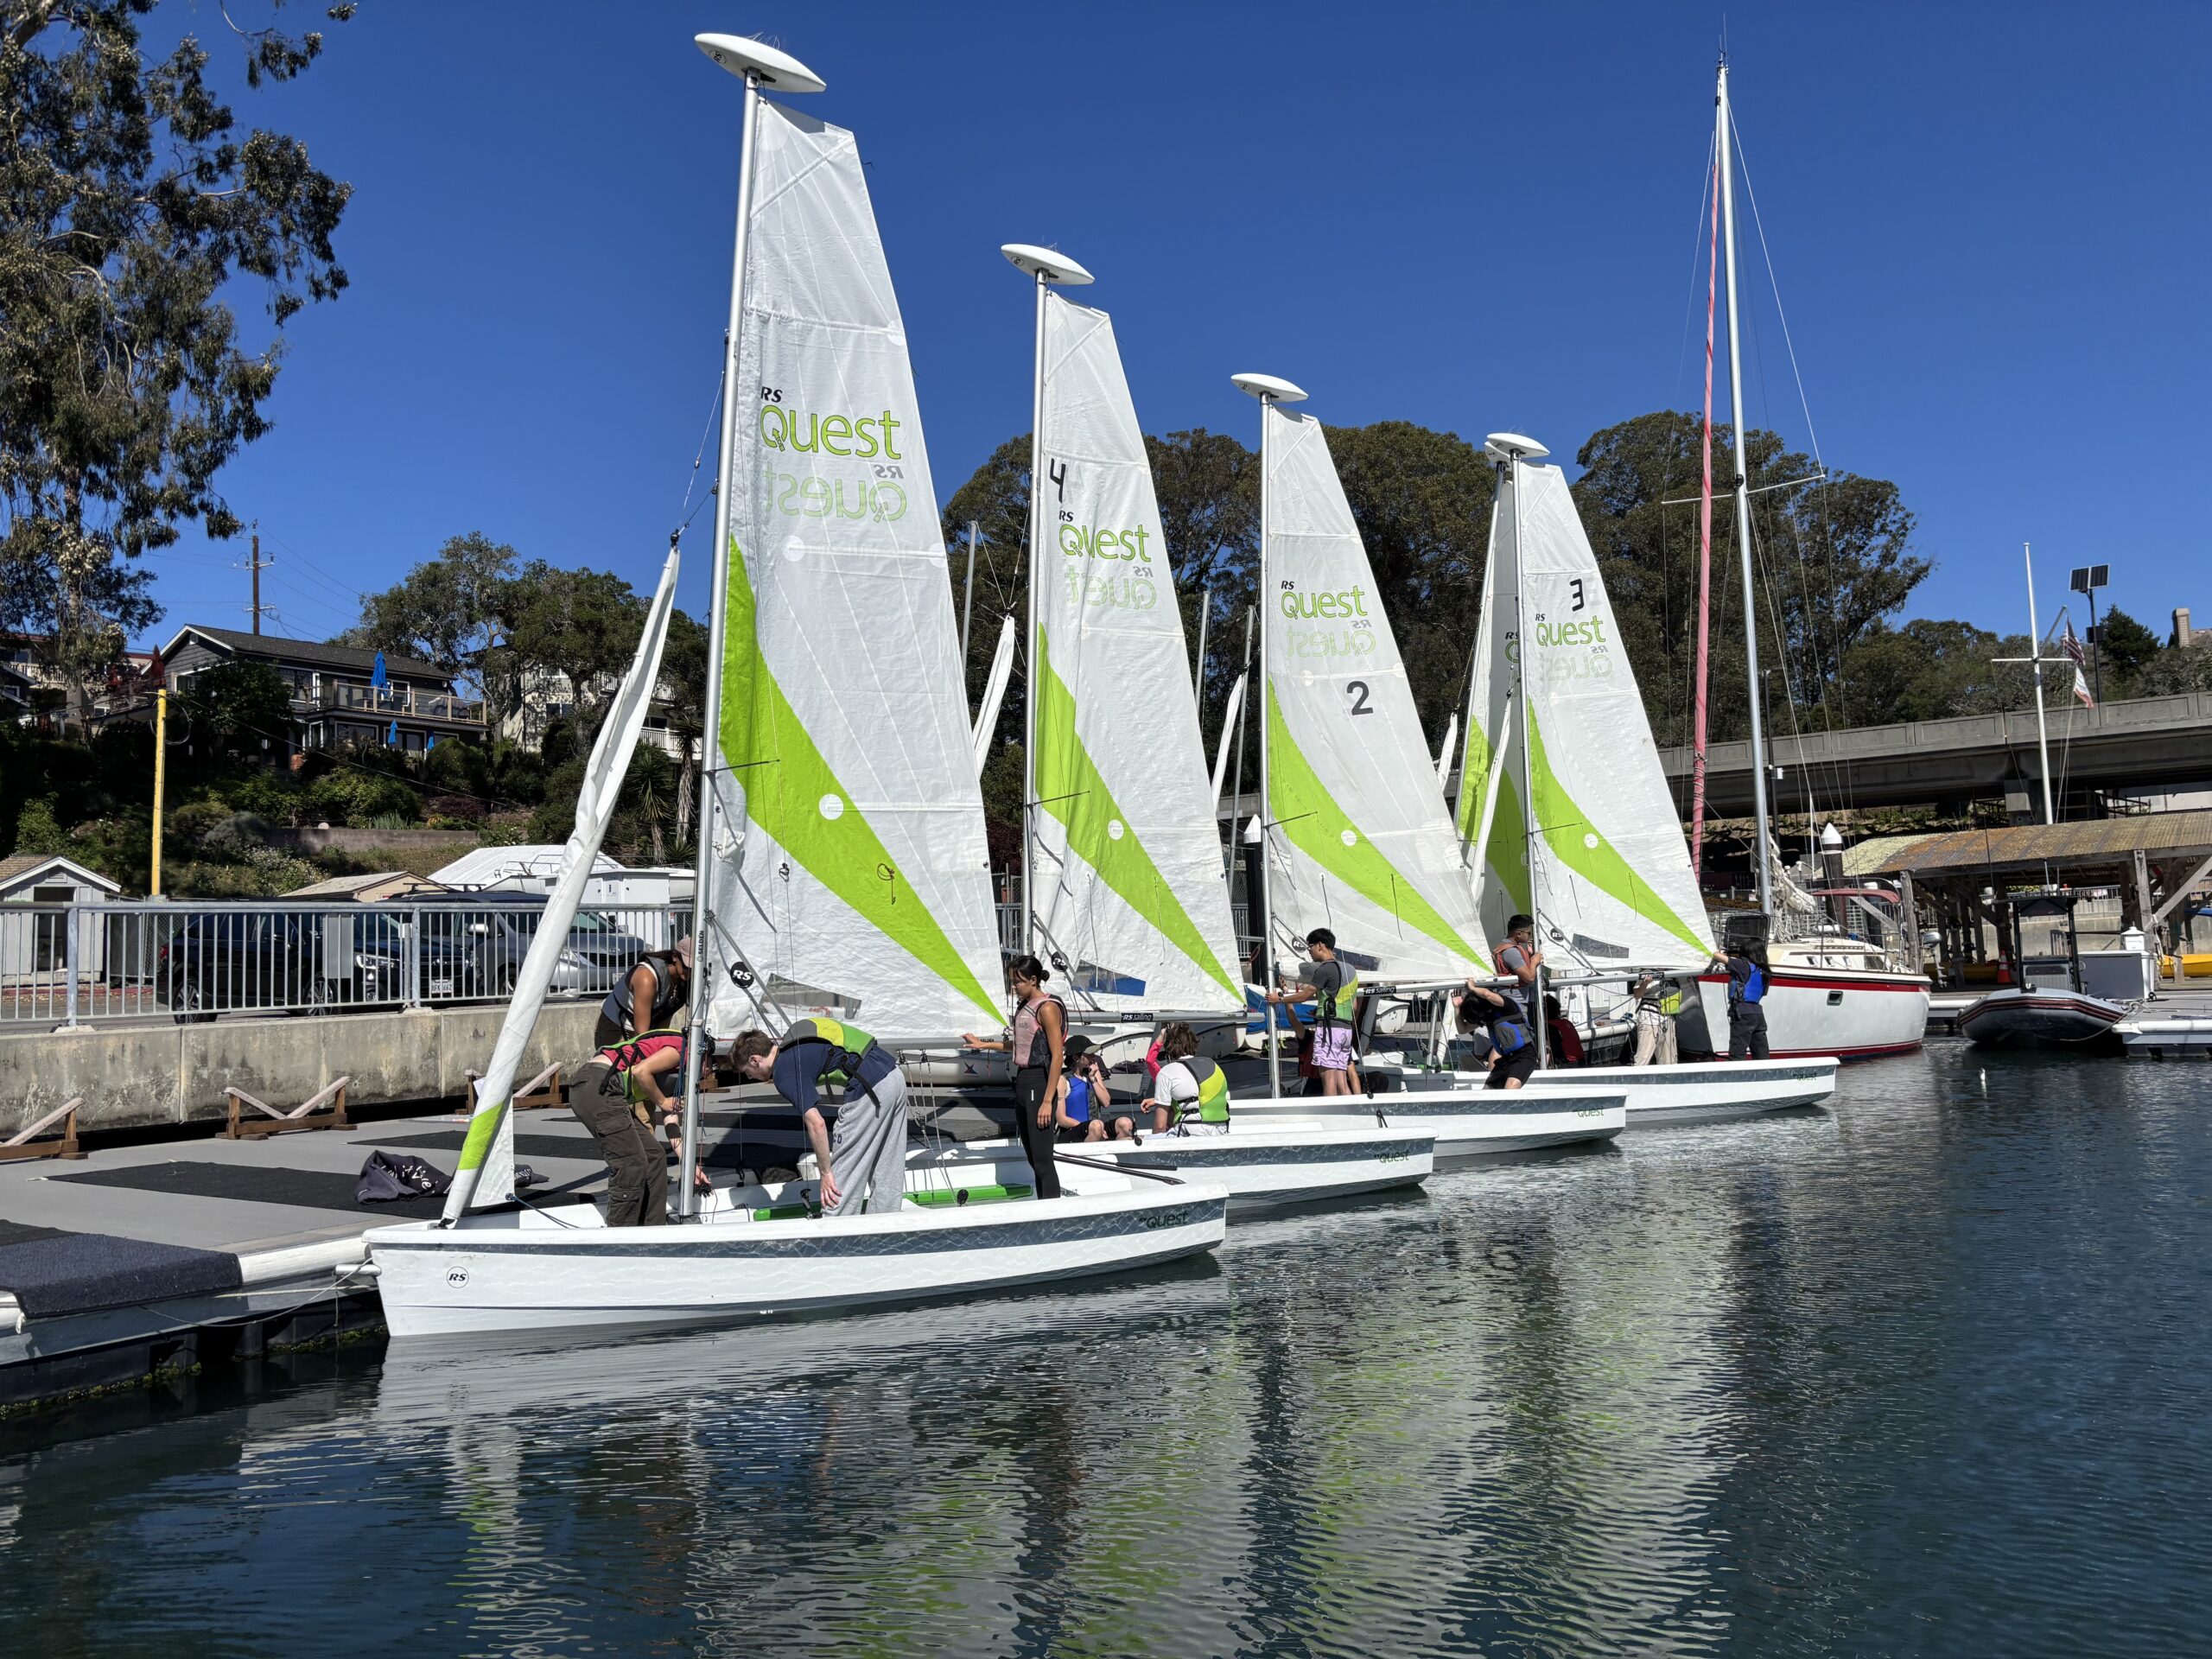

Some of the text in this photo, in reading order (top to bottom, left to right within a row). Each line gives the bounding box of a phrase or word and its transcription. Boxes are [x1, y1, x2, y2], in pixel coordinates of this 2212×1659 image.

[760, 386, 783, 403] RS
[760, 404, 901, 460] Quest
[1049, 458, 1066, 503] 4
[1059, 510, 1074, 522] RS
[1281, 580, 1294, 590] RS
[1281, 586, 1368, 620] Quest
[1569, 578, 1585, 612] 3
[1535, 615, 1606, 647] Quest
[1346, 680, 1374, 715] 2
[733, 969, 753, 981] RS
[1577, 1106, 1604, 1117] Quest
[1379, 1148, 1409, 1164] Quest
[1147, 1211, 1189, 1228] Quest
[449, 1273, 467, 1281] RS
